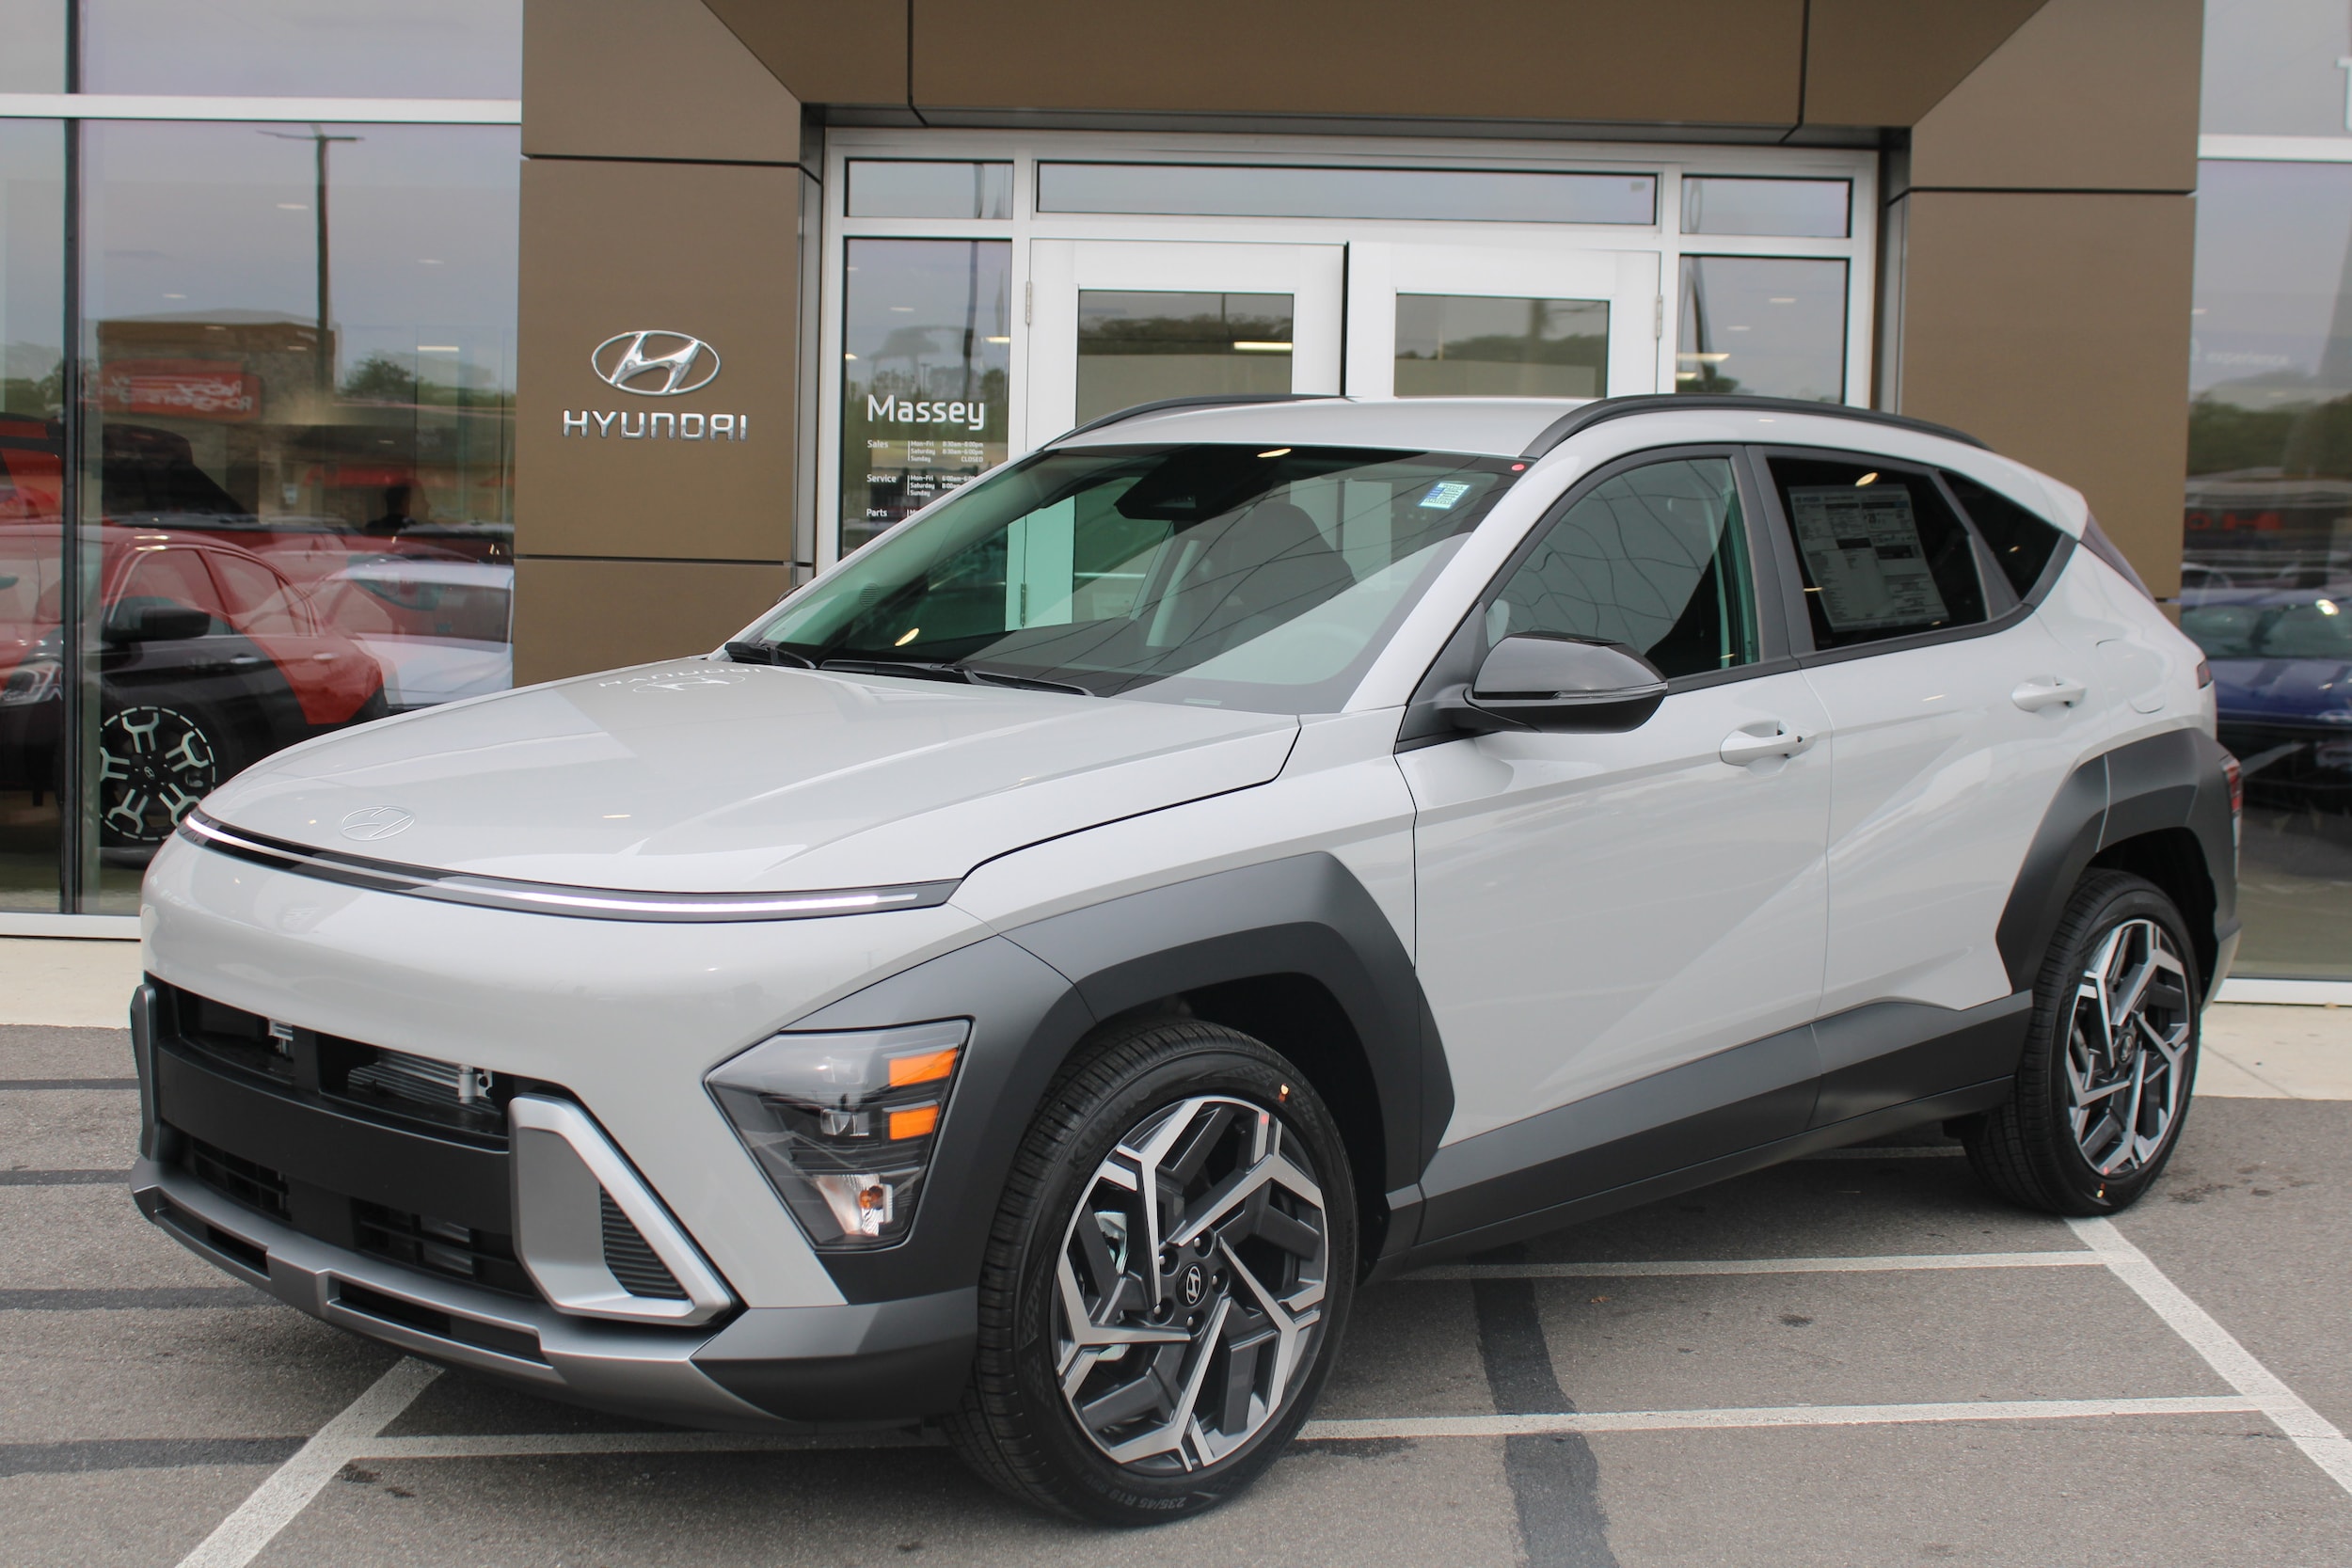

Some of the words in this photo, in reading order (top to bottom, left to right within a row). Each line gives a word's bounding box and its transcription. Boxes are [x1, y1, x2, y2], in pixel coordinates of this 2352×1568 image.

[867, 394, 985, 431] Massey
[563, 409, 747, 441] HYUNDAI
[866, 439, 889, 449] Sales
[866, 474, 897, 483] Service
[866, 508, 888, 517] Parts
[1136, 1496, 1186, 1511] 235/45
